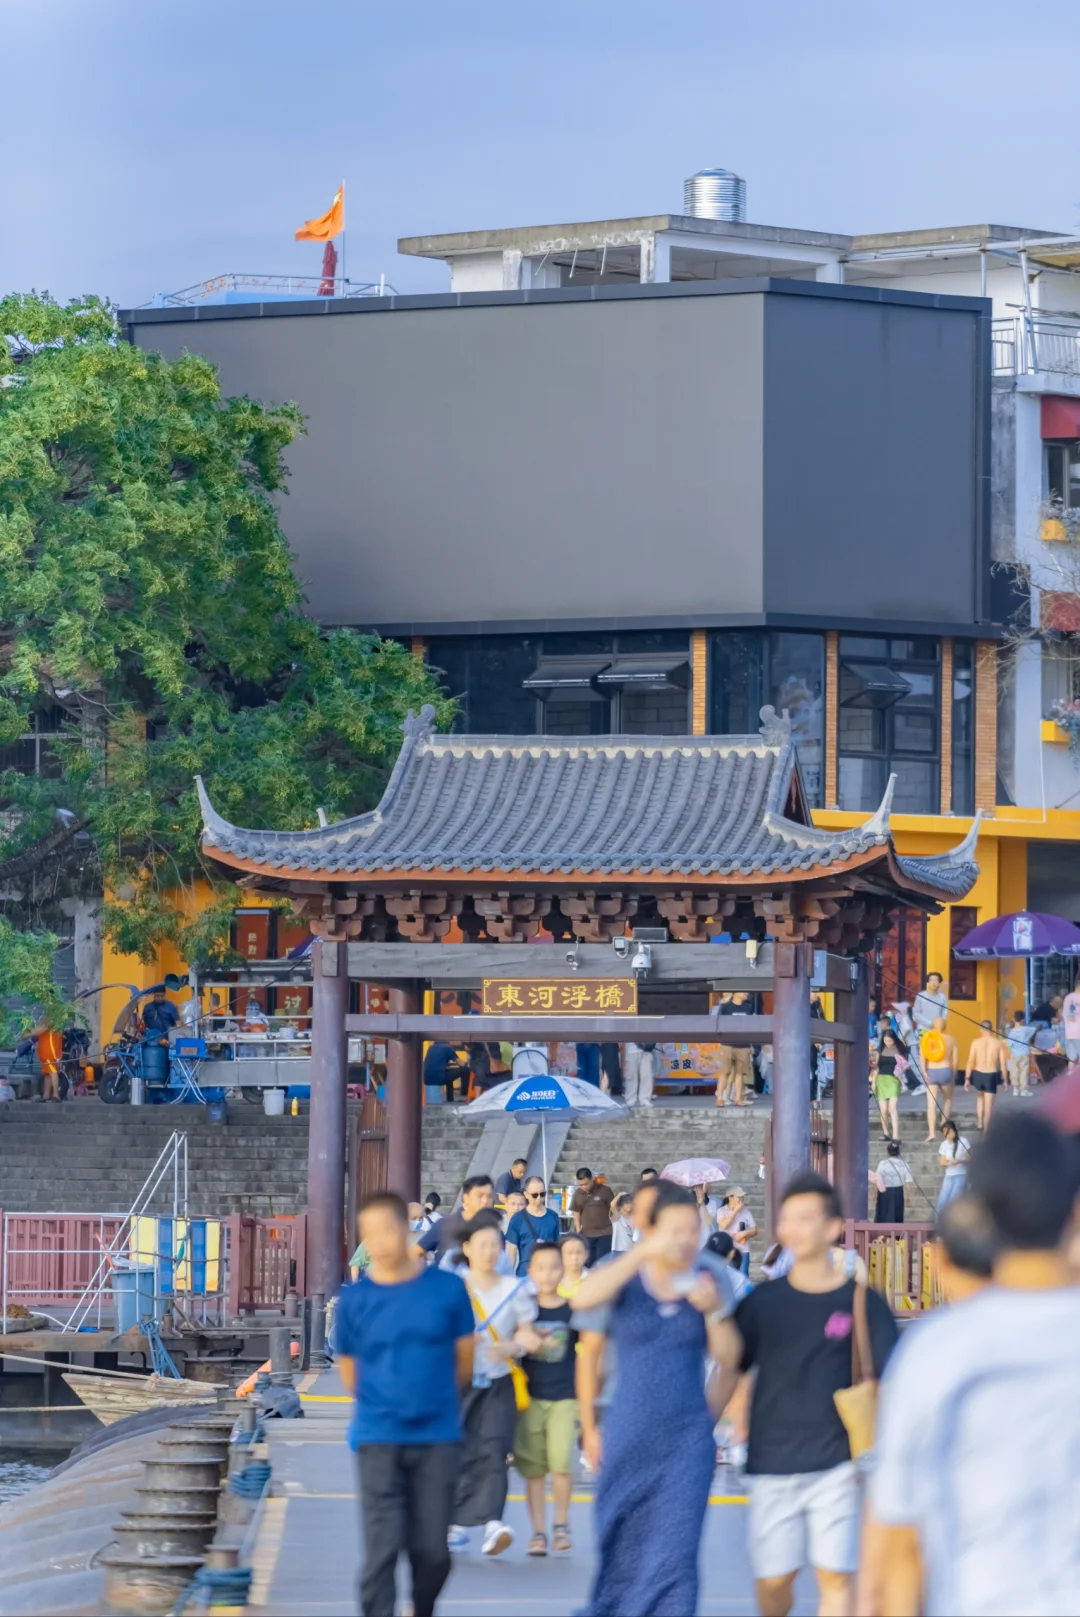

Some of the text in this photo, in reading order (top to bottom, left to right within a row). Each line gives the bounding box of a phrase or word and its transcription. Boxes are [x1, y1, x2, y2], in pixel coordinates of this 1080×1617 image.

[496, 984, 624, 1008] 東河浮橋
[670, 1059, 692, 1070] 凉皮
